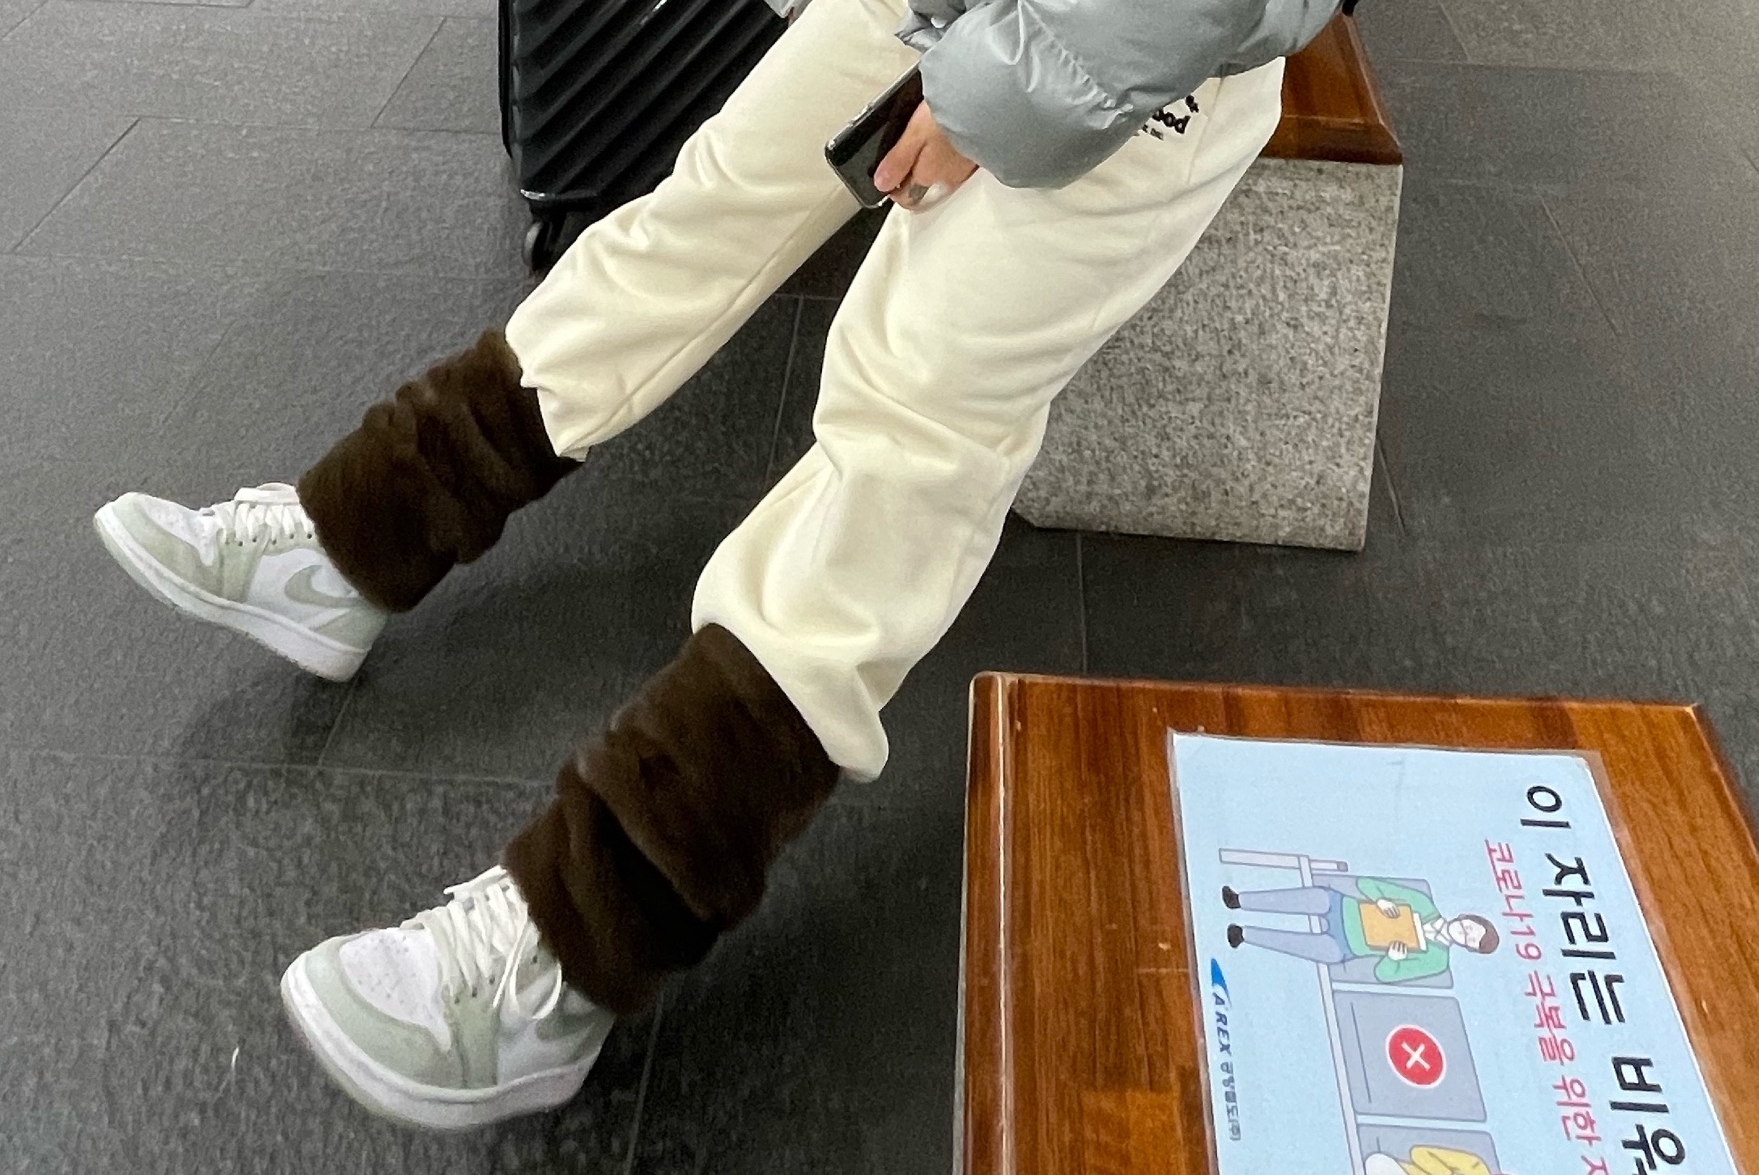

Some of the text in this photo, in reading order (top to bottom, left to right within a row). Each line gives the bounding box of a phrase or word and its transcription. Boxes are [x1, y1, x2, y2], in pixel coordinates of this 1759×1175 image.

[1519, 785, 1573, 830] 이
[1484, 838, 1543, 960] 코로나19
[1524, 971, 1576, 1067] 극복을
[1552, 1076, 1601, 1147] 위한
[1543, 852, 1627, 1026] 자리는
[1212, 992, 1232, 1056] AREX
